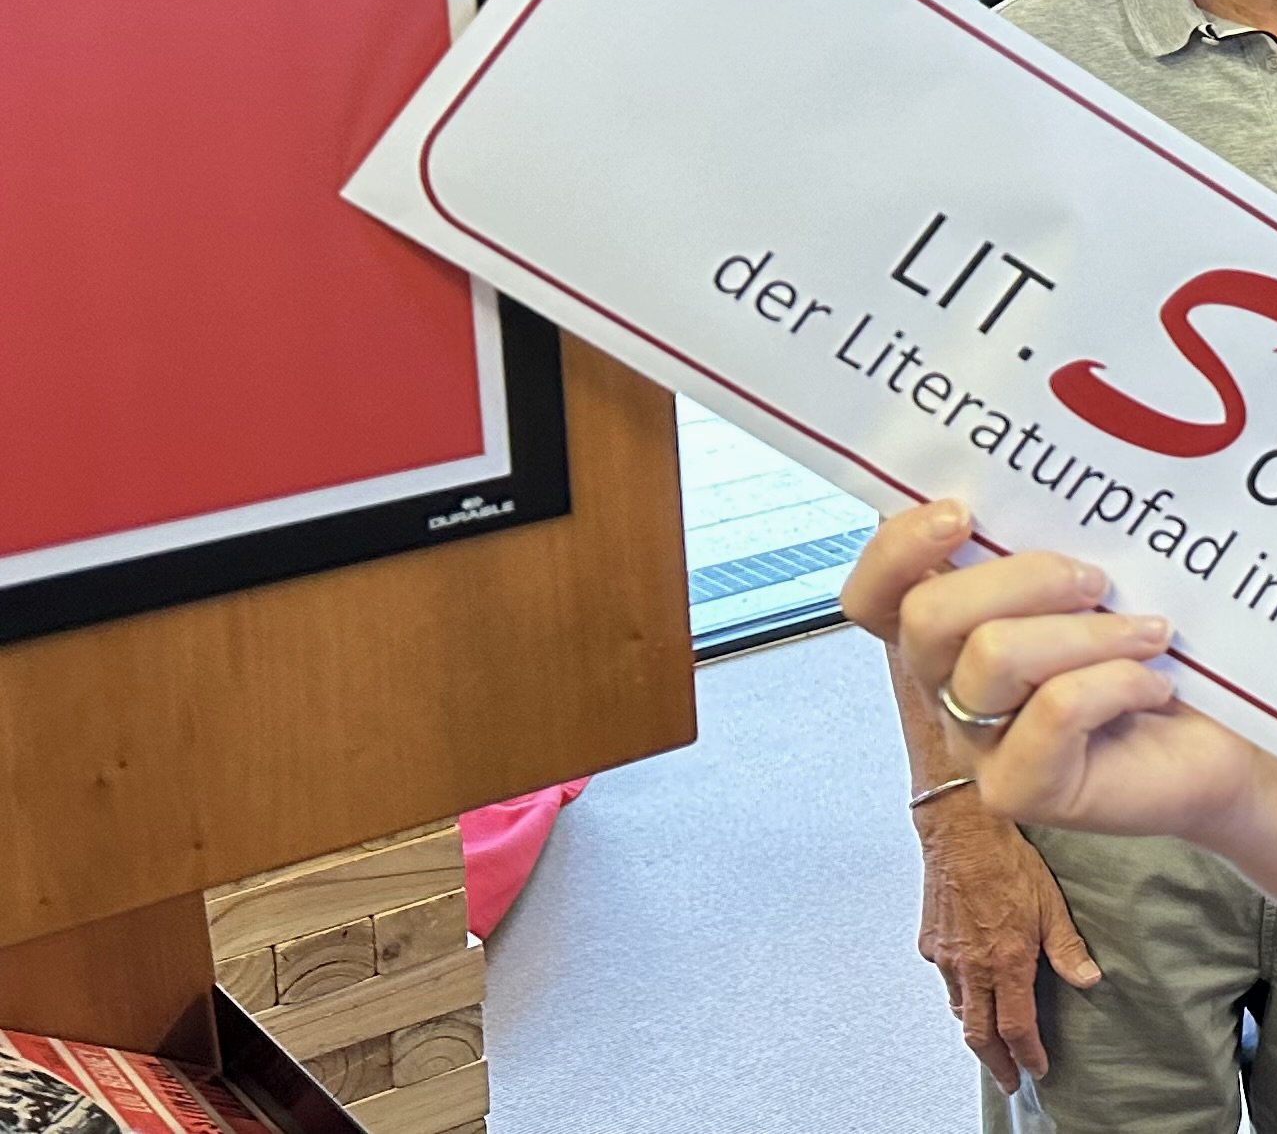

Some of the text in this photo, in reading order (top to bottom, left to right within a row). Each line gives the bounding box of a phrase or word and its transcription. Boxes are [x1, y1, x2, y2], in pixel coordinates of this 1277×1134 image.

[889, 212, 1056, 364] LIT.
[713, 251, 832, 334] der
[835, 314, 1238, 581] Literaturpfad
[428, 501, 516, 530] DURABLE
